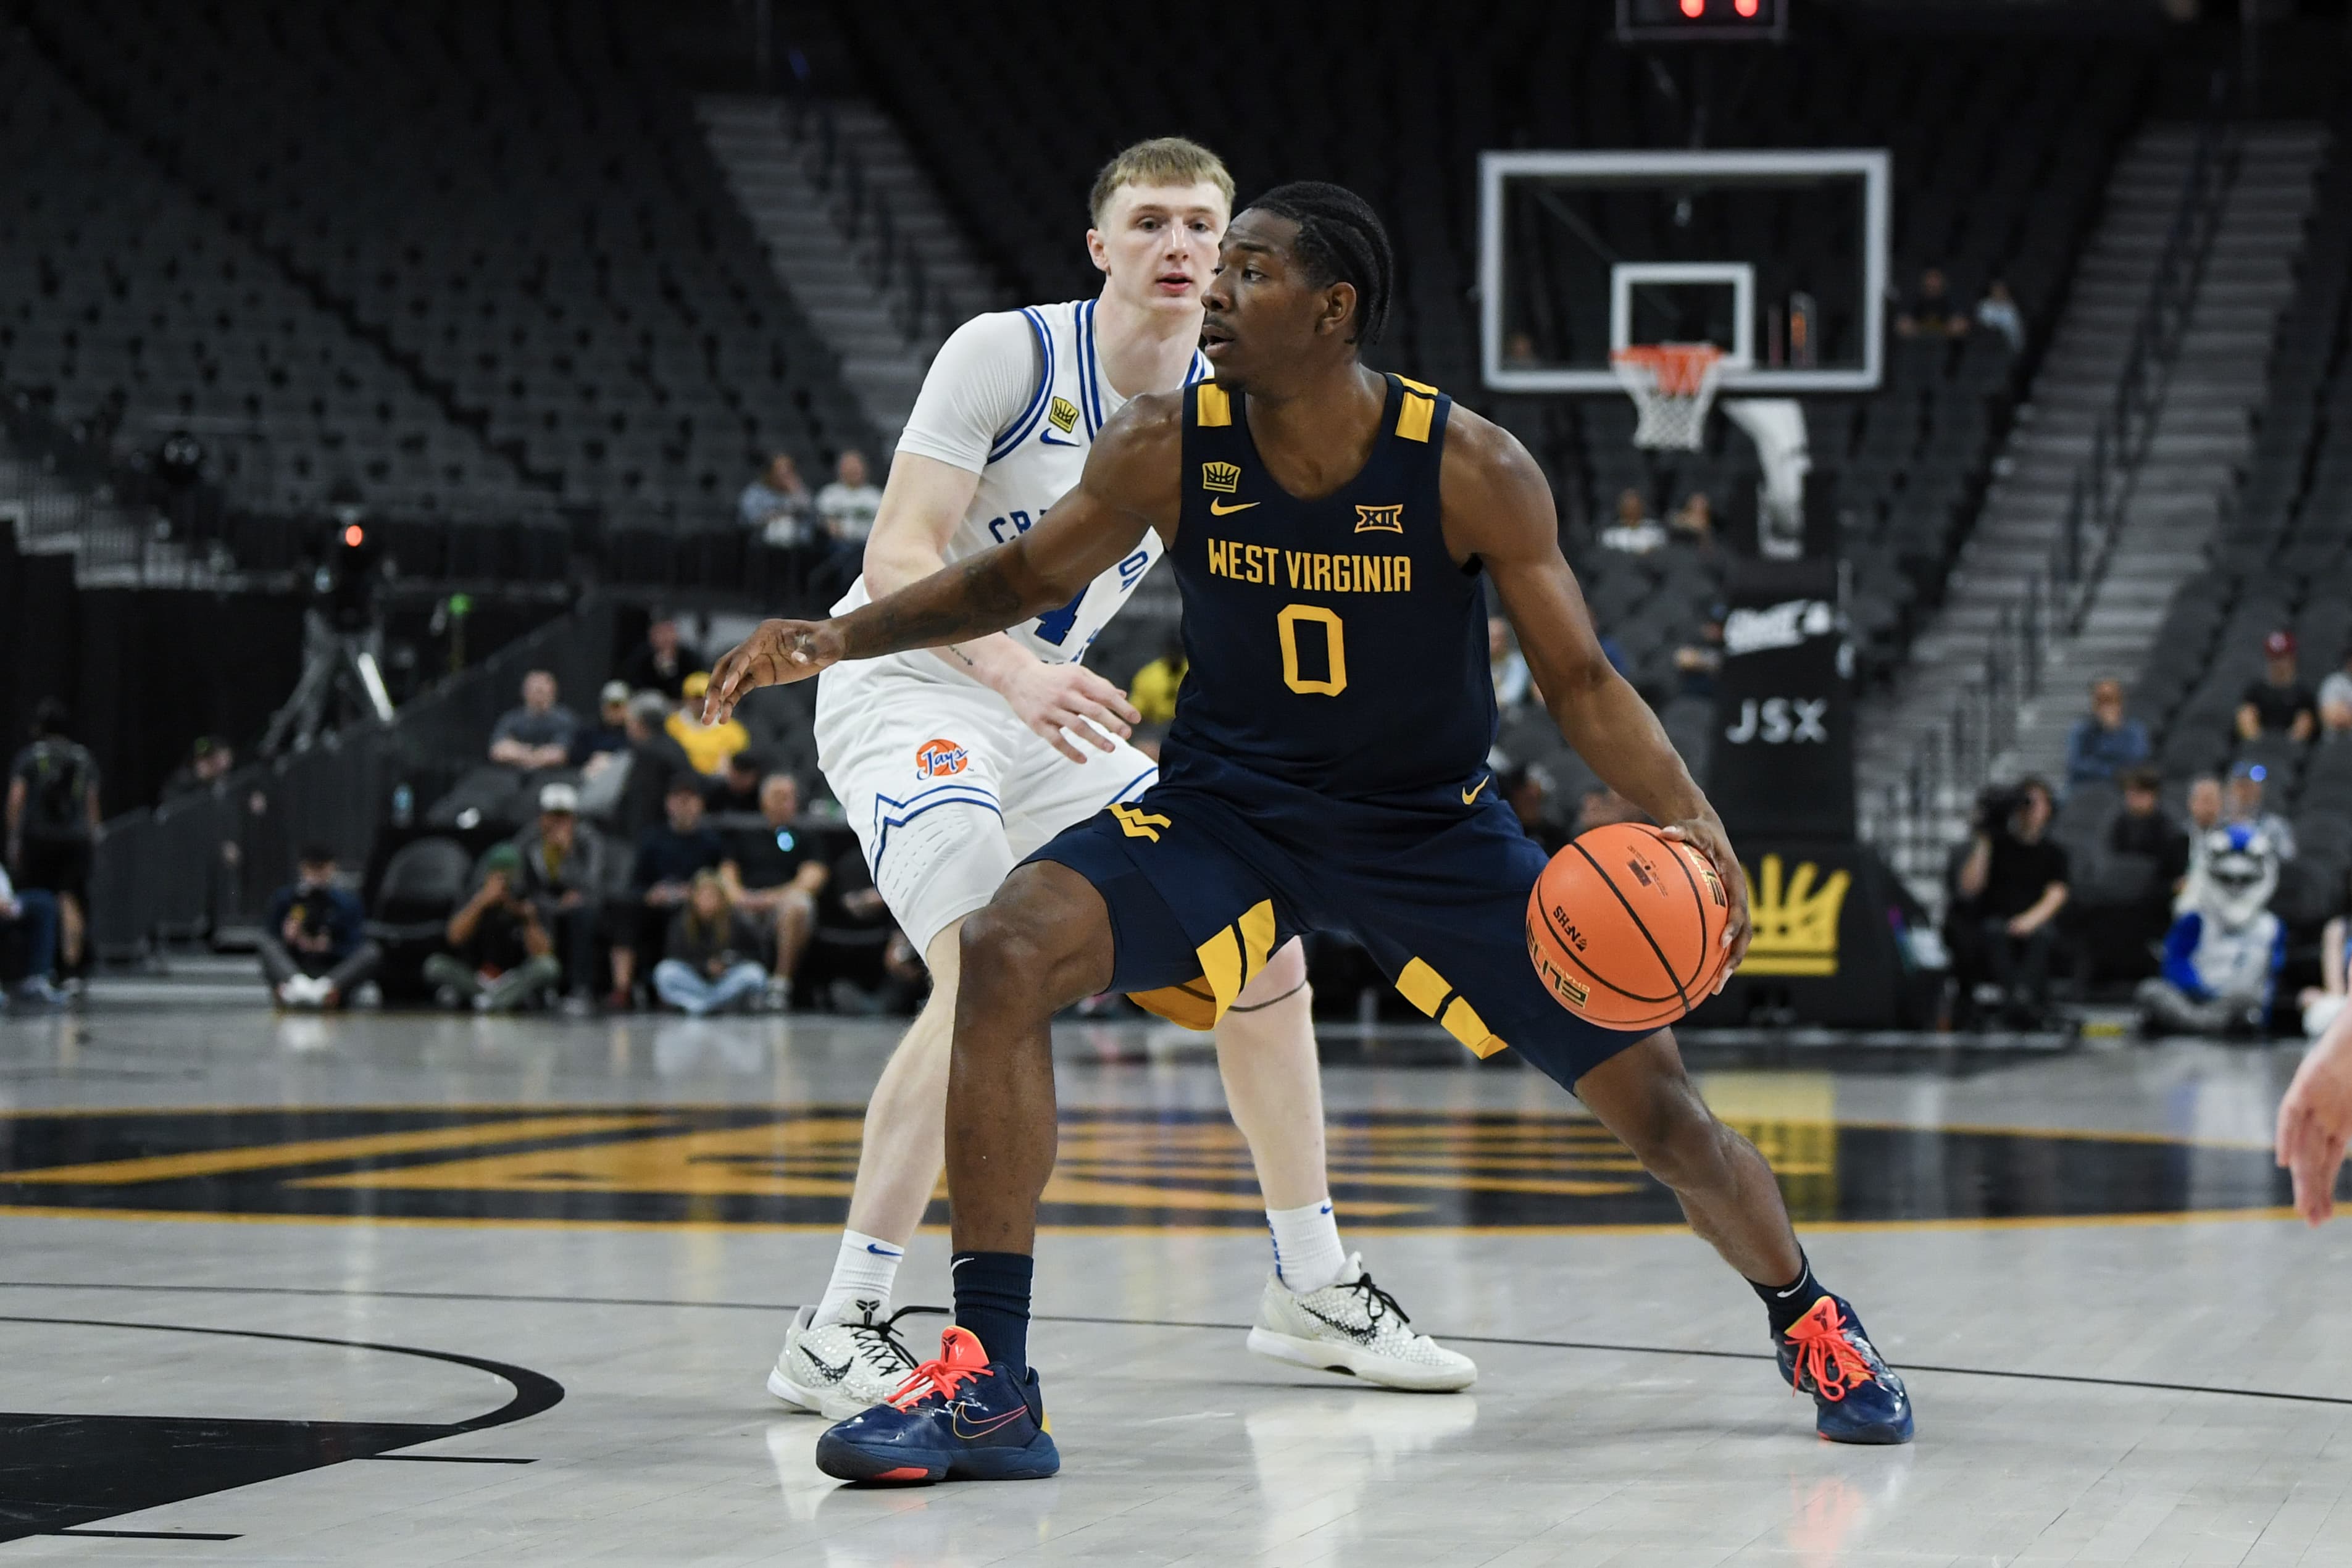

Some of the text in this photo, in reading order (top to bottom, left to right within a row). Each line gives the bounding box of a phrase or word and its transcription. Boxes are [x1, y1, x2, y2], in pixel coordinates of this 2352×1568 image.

[1207, 538, 1412, 593] WEST VIRGINIA
[1277, 603, 1348, 698] 0
[1725, 697, 1827, 744] JSX
[916, 748, 969, 781] Jays
[1553, 905, 1581, 943] NFHS
[1526, 918, 1588, 1010] ELITE
